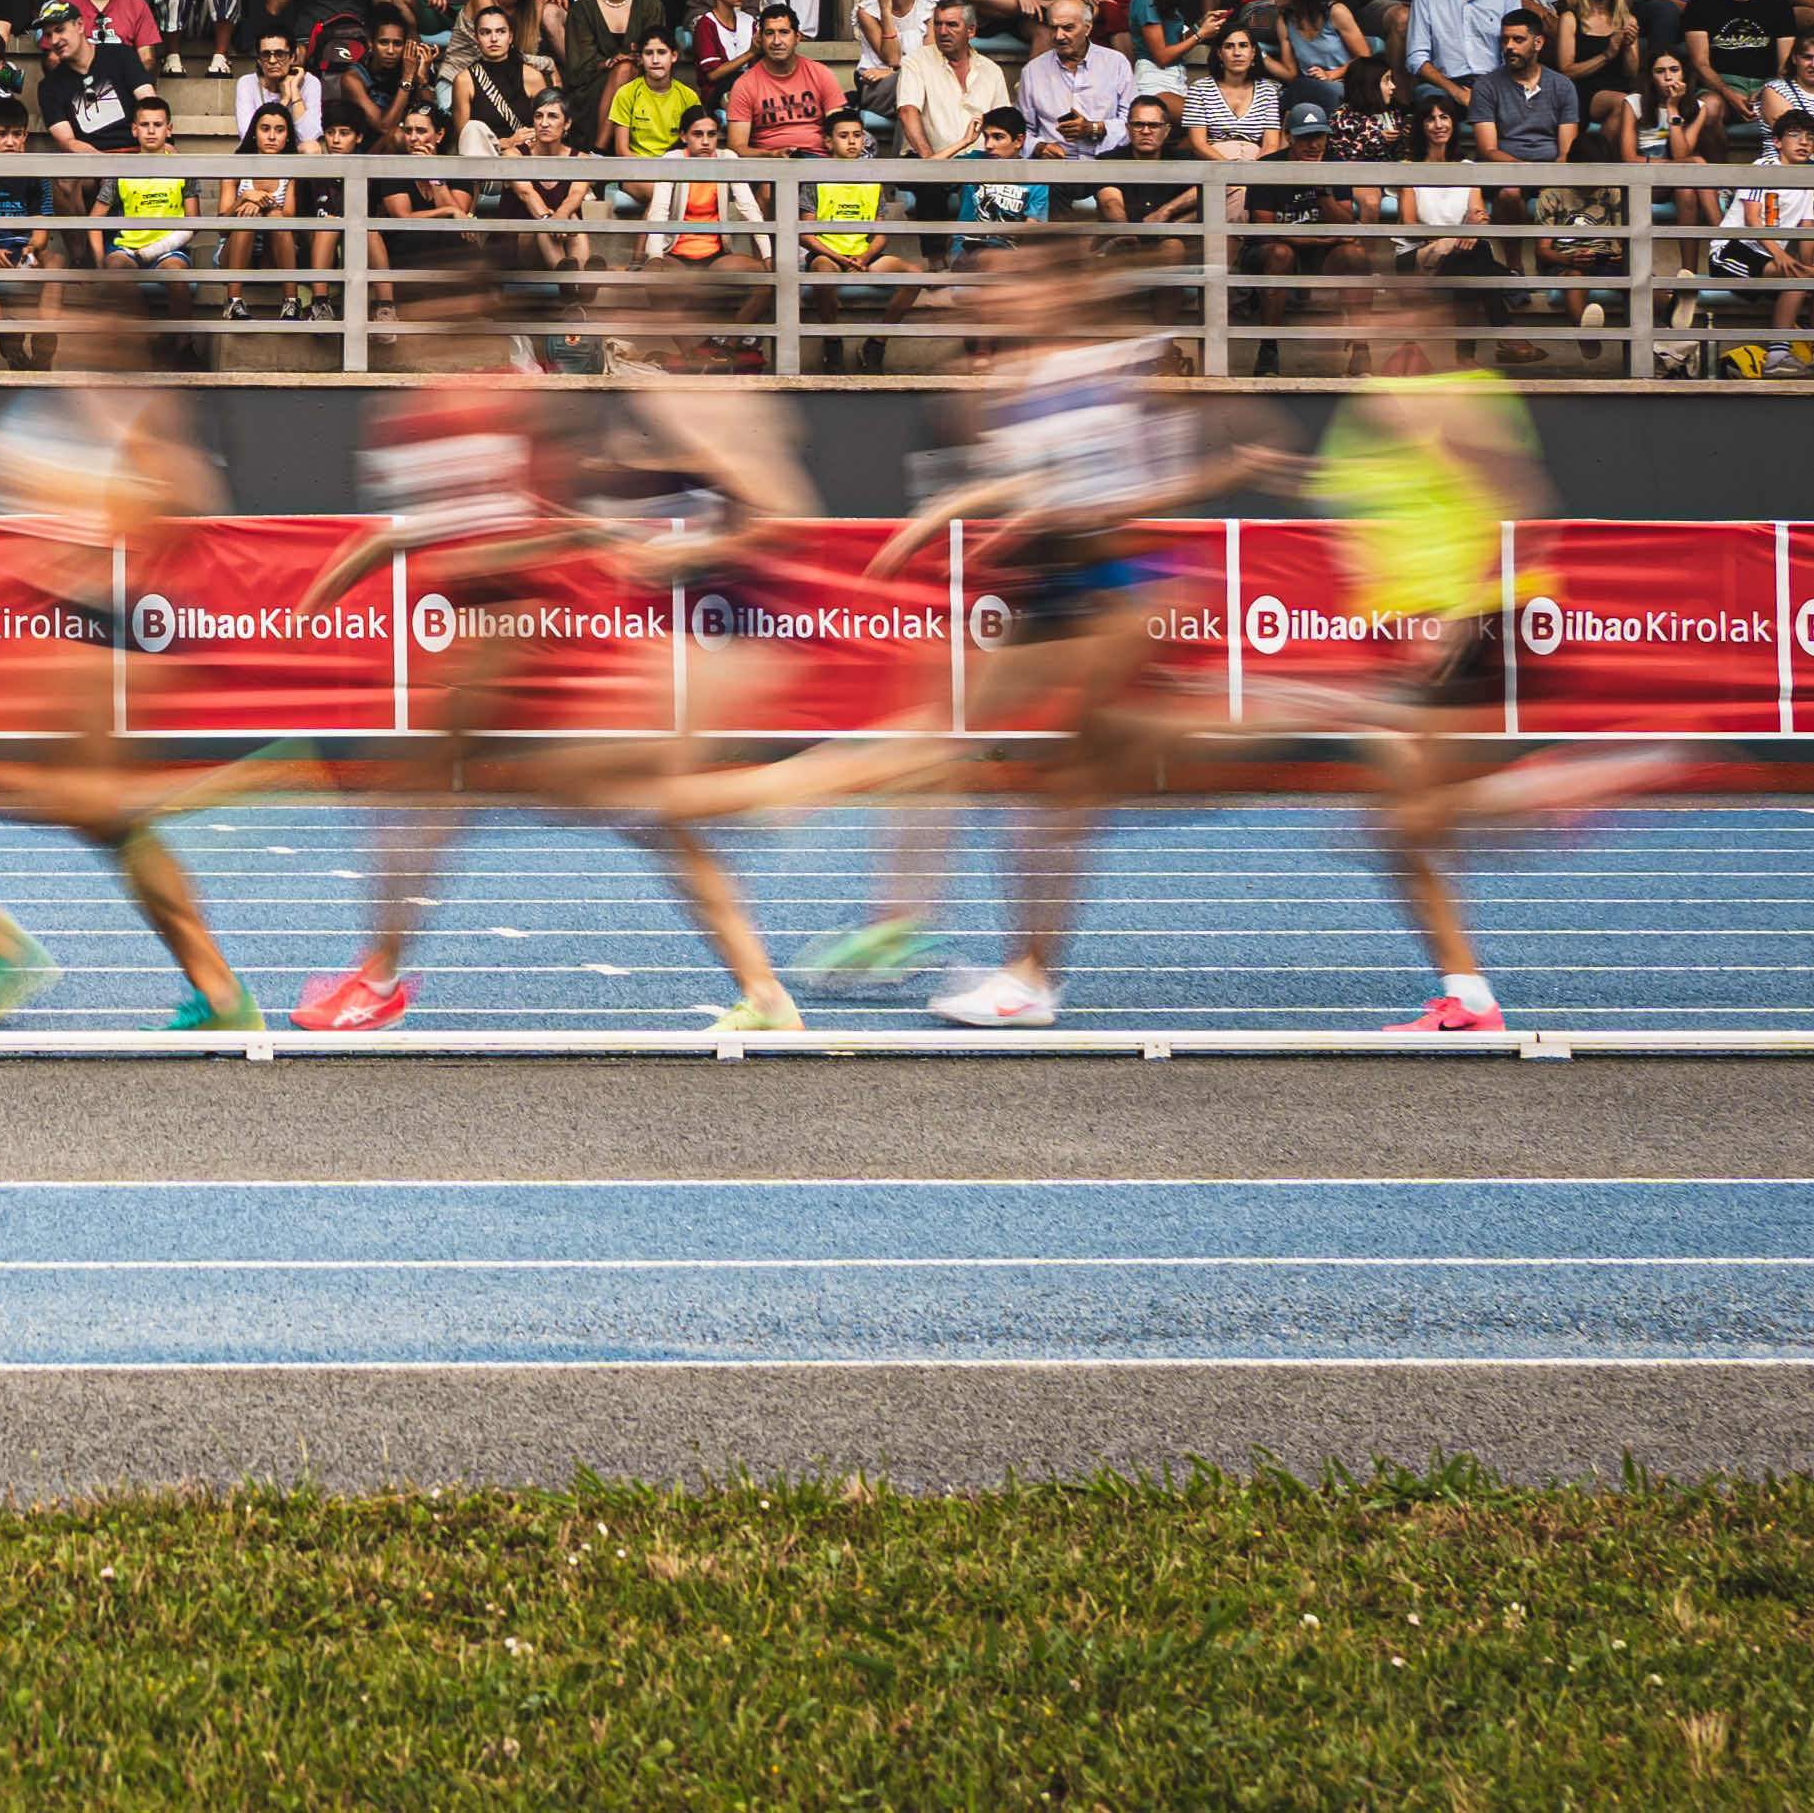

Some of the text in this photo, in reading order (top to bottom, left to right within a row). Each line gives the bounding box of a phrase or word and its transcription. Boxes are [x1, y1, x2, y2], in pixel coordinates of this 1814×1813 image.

[140, 605, 388, 641] BilbaoKirolak
[422, 604, 666, 640] BilbaoKirolak
[700, 604, 945, 641] BilbaoKirolak
[1255, 607, 1497, 642] BilbaoKirok
[1529, 608, 1774, 643] BilbaoKirolak
